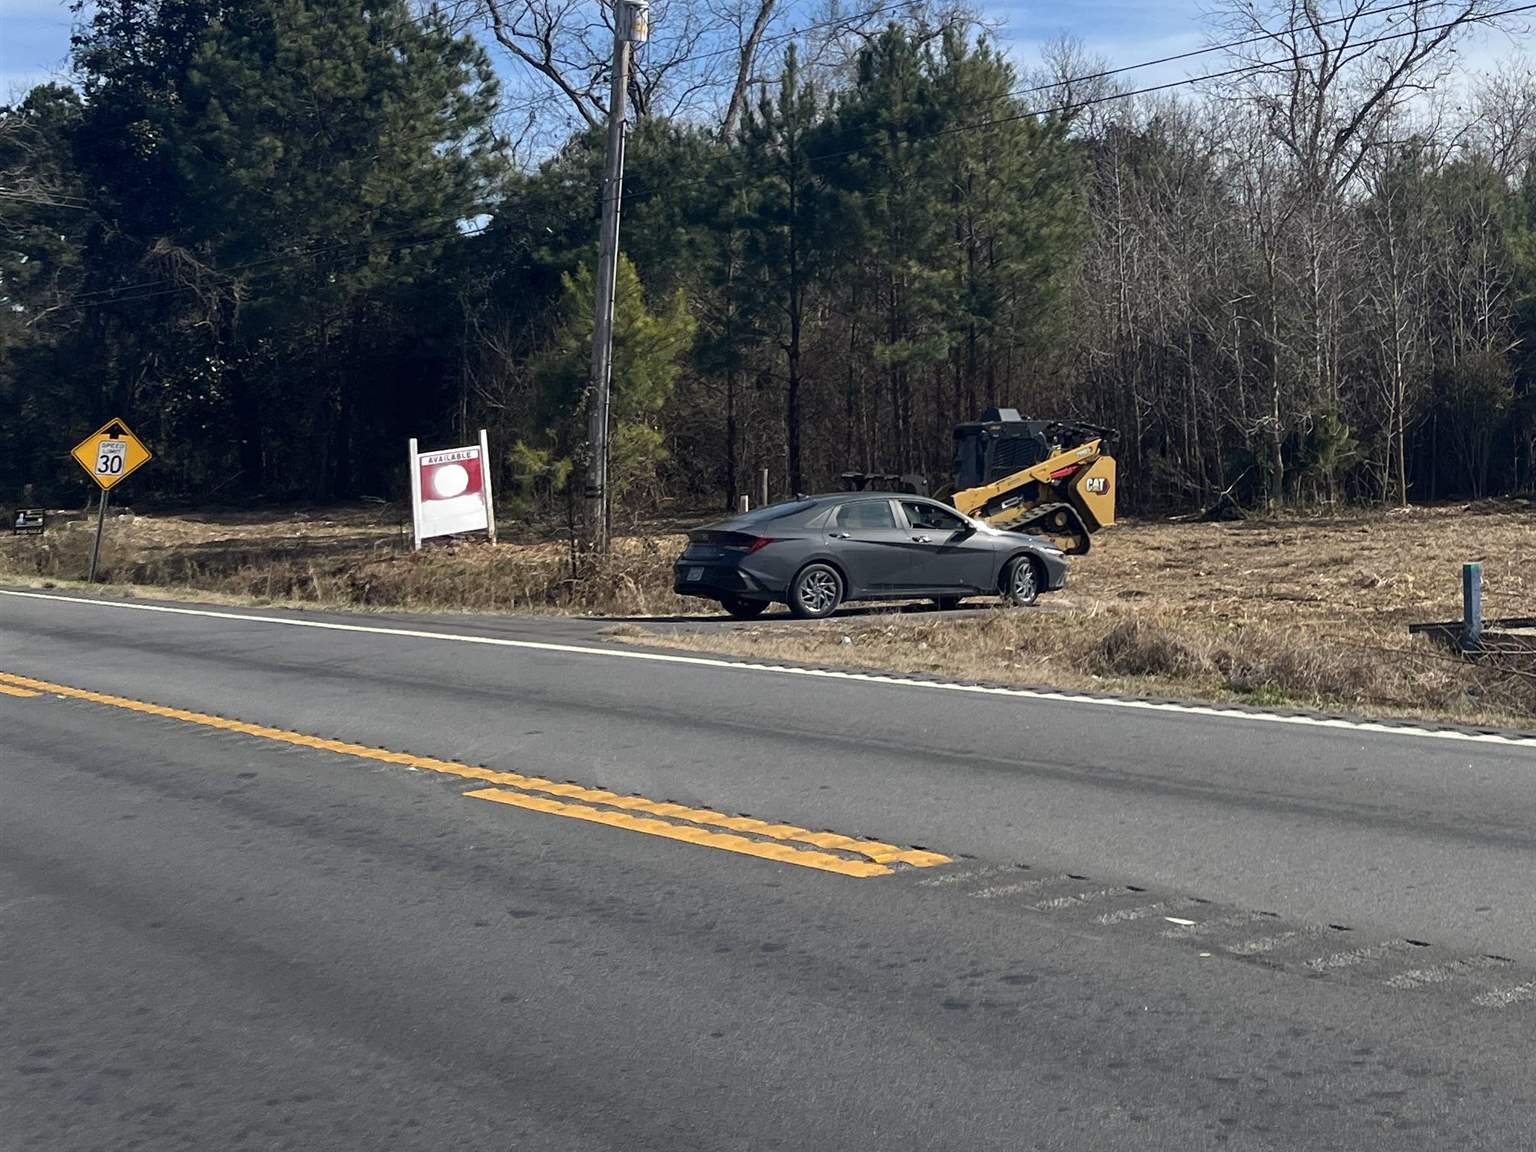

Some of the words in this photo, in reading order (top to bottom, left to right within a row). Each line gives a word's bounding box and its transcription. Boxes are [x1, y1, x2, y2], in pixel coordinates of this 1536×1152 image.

[98, 455, 122, 473] 30
[428, 451, 471, 463] AVAILABLE
[1086, 478, 1105, 492] CAT
